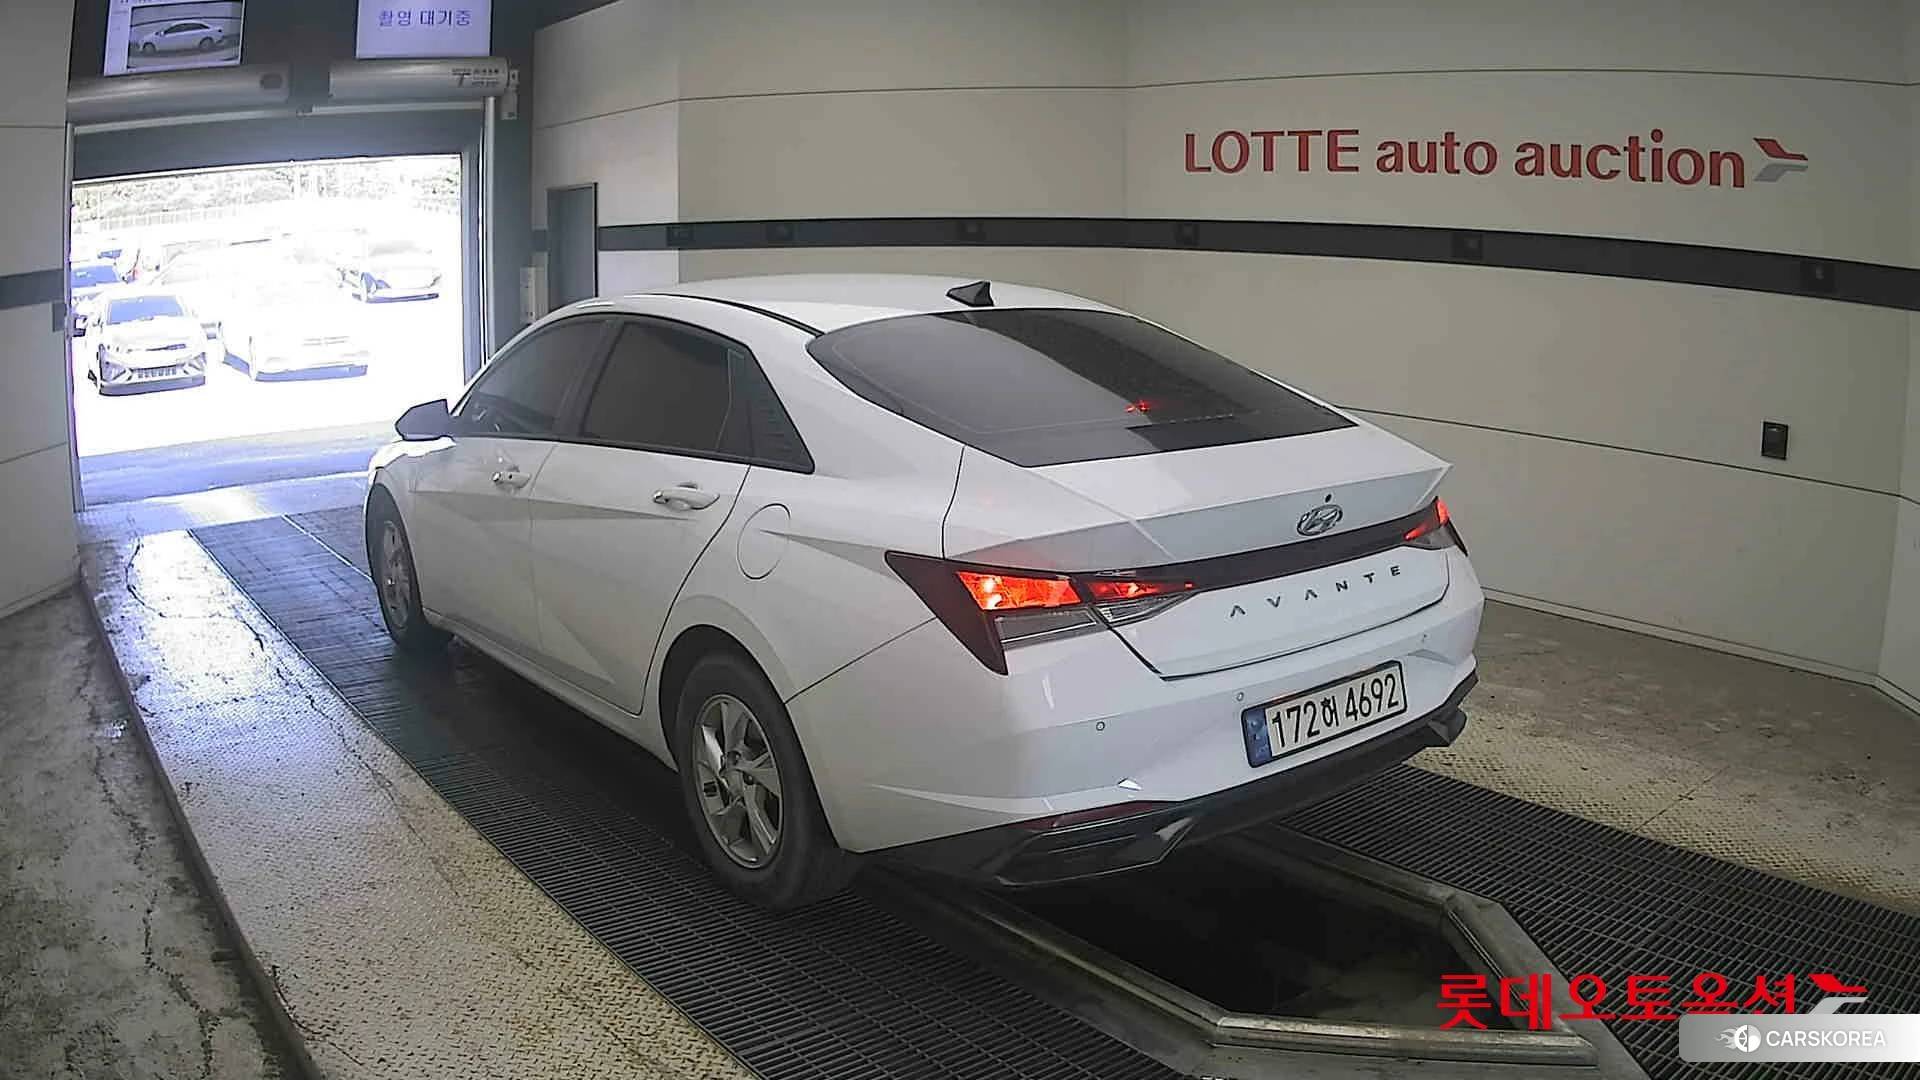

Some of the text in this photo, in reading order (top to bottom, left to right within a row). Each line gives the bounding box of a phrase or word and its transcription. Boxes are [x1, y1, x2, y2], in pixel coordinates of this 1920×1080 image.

[420, 9, 471, 26] 대기중
[1184, 128, 1746, 188] LOTTE auto auction
[1229, 564, 1401, 618] AVANTE
[1271, 673, 1399, 747] 172허 4692
